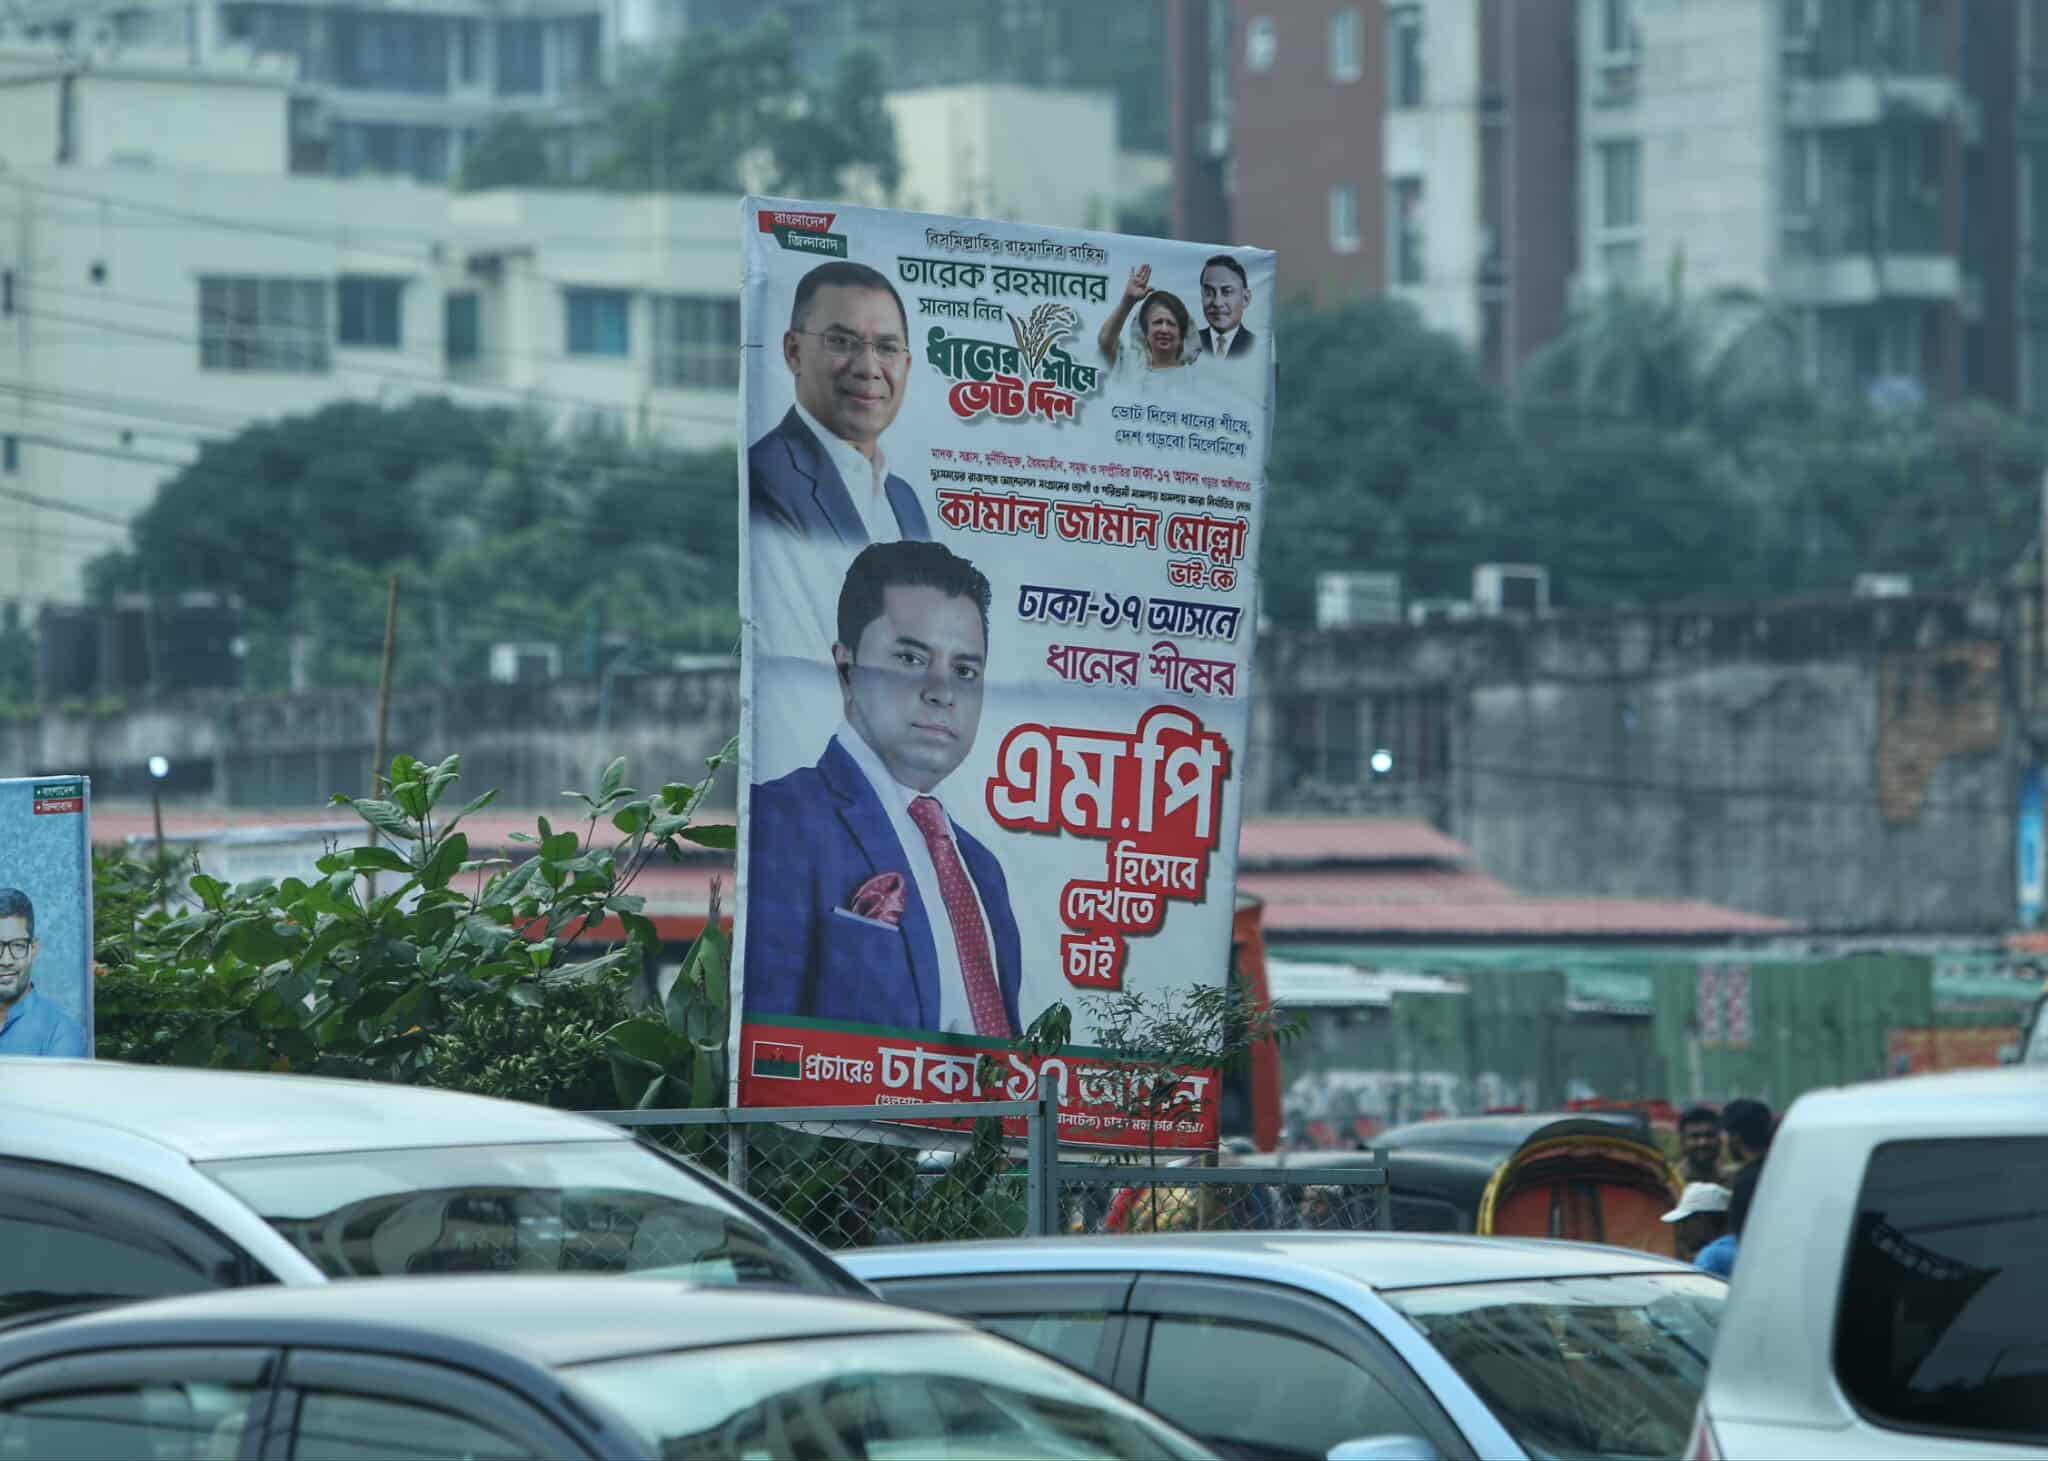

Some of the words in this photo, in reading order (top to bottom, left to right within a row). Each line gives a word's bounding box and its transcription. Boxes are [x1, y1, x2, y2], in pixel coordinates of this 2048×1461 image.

[774, 212, 827, 228] বাংলাদেশ
[897, 256, 985, 288] তারেক
[991, 265, 1109, 303] রহমানের
[918, 297, 969, 318] সালাম
[974, 298, 1003, 321] নিন
[926, 326, 1019, 381] ধানের
[1042, 343, 1099, 391] শীষে
[949, 373, 1024, 417] ভোট
[1028, 381, 1078, 421] দিন
[1111, 404, 1143, 420] ভোট
[1147, 405, 1177, 425] দিলে
[1181, 413, 1215, 430] ধানের
[1115, 429, 1141, 444] দেশ
[1188, 432, 1246, 457] মিলেমিশে
[1133, 466, 1170, 483] ঢাকা-১৭
[1173, 470, 1199, 484] আসন
[939, 491, 1049, 536] কামাল
[1055, 500, 1160, 546] জামান
[1167, 514, 1248, 565] মোল্লা
[1018, 584, 1141, 628] ঢাকা-১৭
[1148, 598, 1241, 639] আসনে
[1047, 644, 1141, 686] ধানের
[1149, 640, 1237, 696] শীষের
[993, 711, 1221, 838] এম.পি
[1114, 839, 1199, 891] হিসেবে
[1067, 886, 1157, 925] দেখতে
[1067, 936, 1116, 979] চাই
[805, 1053, 874, 1084] প্রচারেঃ
